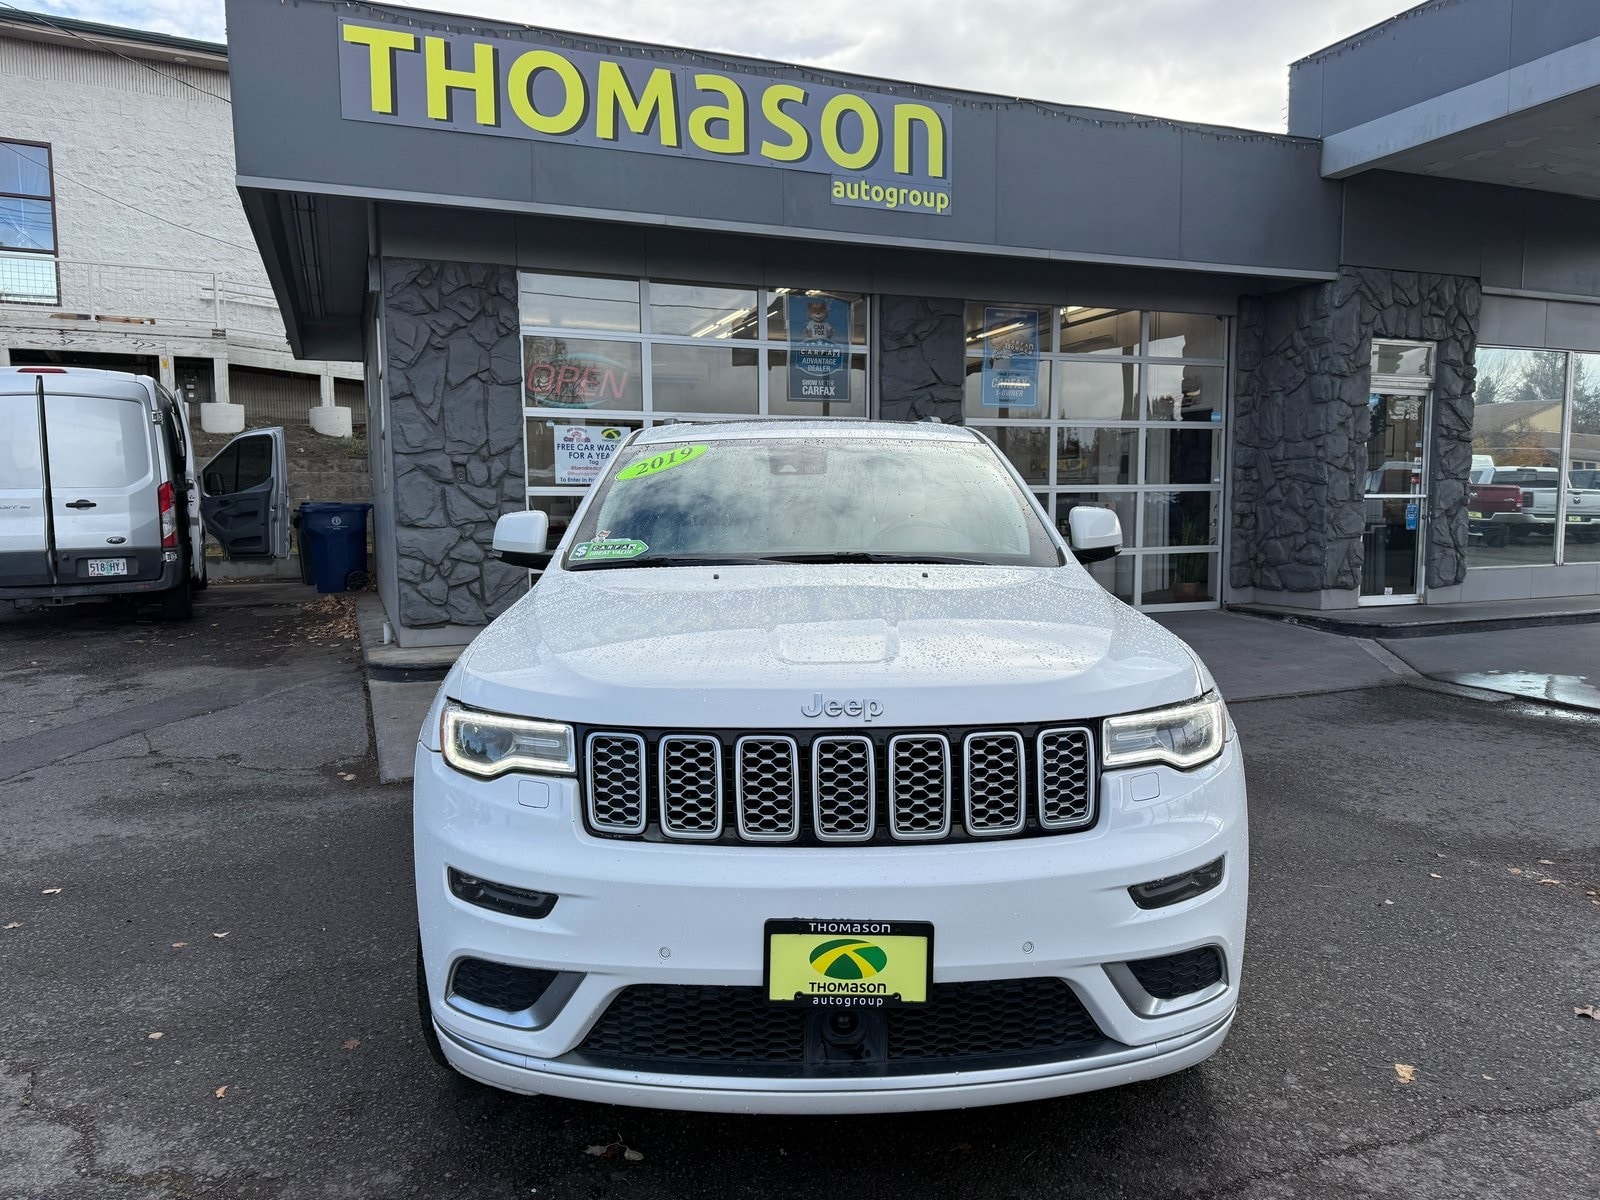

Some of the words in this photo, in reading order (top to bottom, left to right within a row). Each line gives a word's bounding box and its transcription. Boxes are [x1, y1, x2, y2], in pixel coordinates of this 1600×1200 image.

[831, 180, 950, 212] autogroup
[800, 347, 840, 357] CARFAX
[802, 357, 837, 365] ADVANTAGE
[527, 364, 628, 399] OPEN
[802, 386, 835, 395] CARFAX
[577, 444, 595, 452] CAR
[597, 444, 618, 452] WAS
[595, 452, 611, 460] YEA
[635, 447, 693, 476] 2019
[89, 563, 106, 573] 518
[109, 562, 126, 572] HYJ
[801, 692, 884, 722] Jeep
[812, 996, 884, 1008] autogroup
